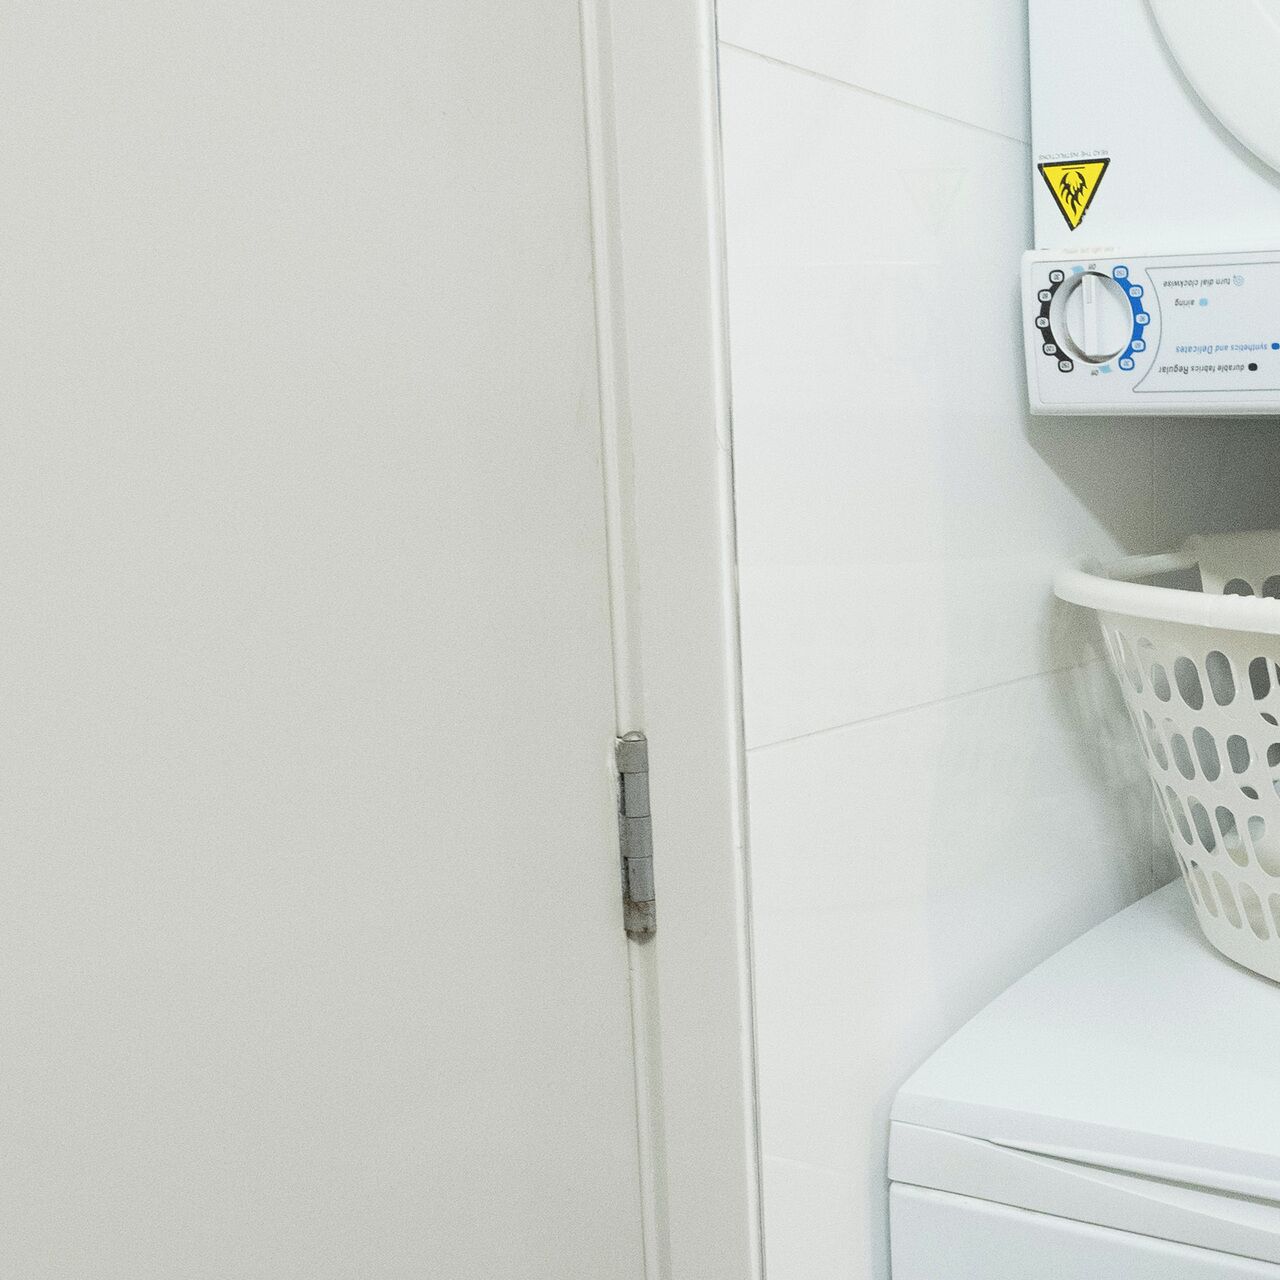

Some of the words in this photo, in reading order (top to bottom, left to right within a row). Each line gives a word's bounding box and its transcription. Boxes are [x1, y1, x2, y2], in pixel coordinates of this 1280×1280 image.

[1163, 280, 1199, 288] clockwise
[1174, 299, 1195, 308] airing
[1176, 345, 1213, 354] Delicates
[1230, 342, 1267, 351] synthetics
[1158, 364, 1188, 375] Regular
[1191, 365, 1216, 373] fabrics
[1218, 364, 1245, 372] durable
